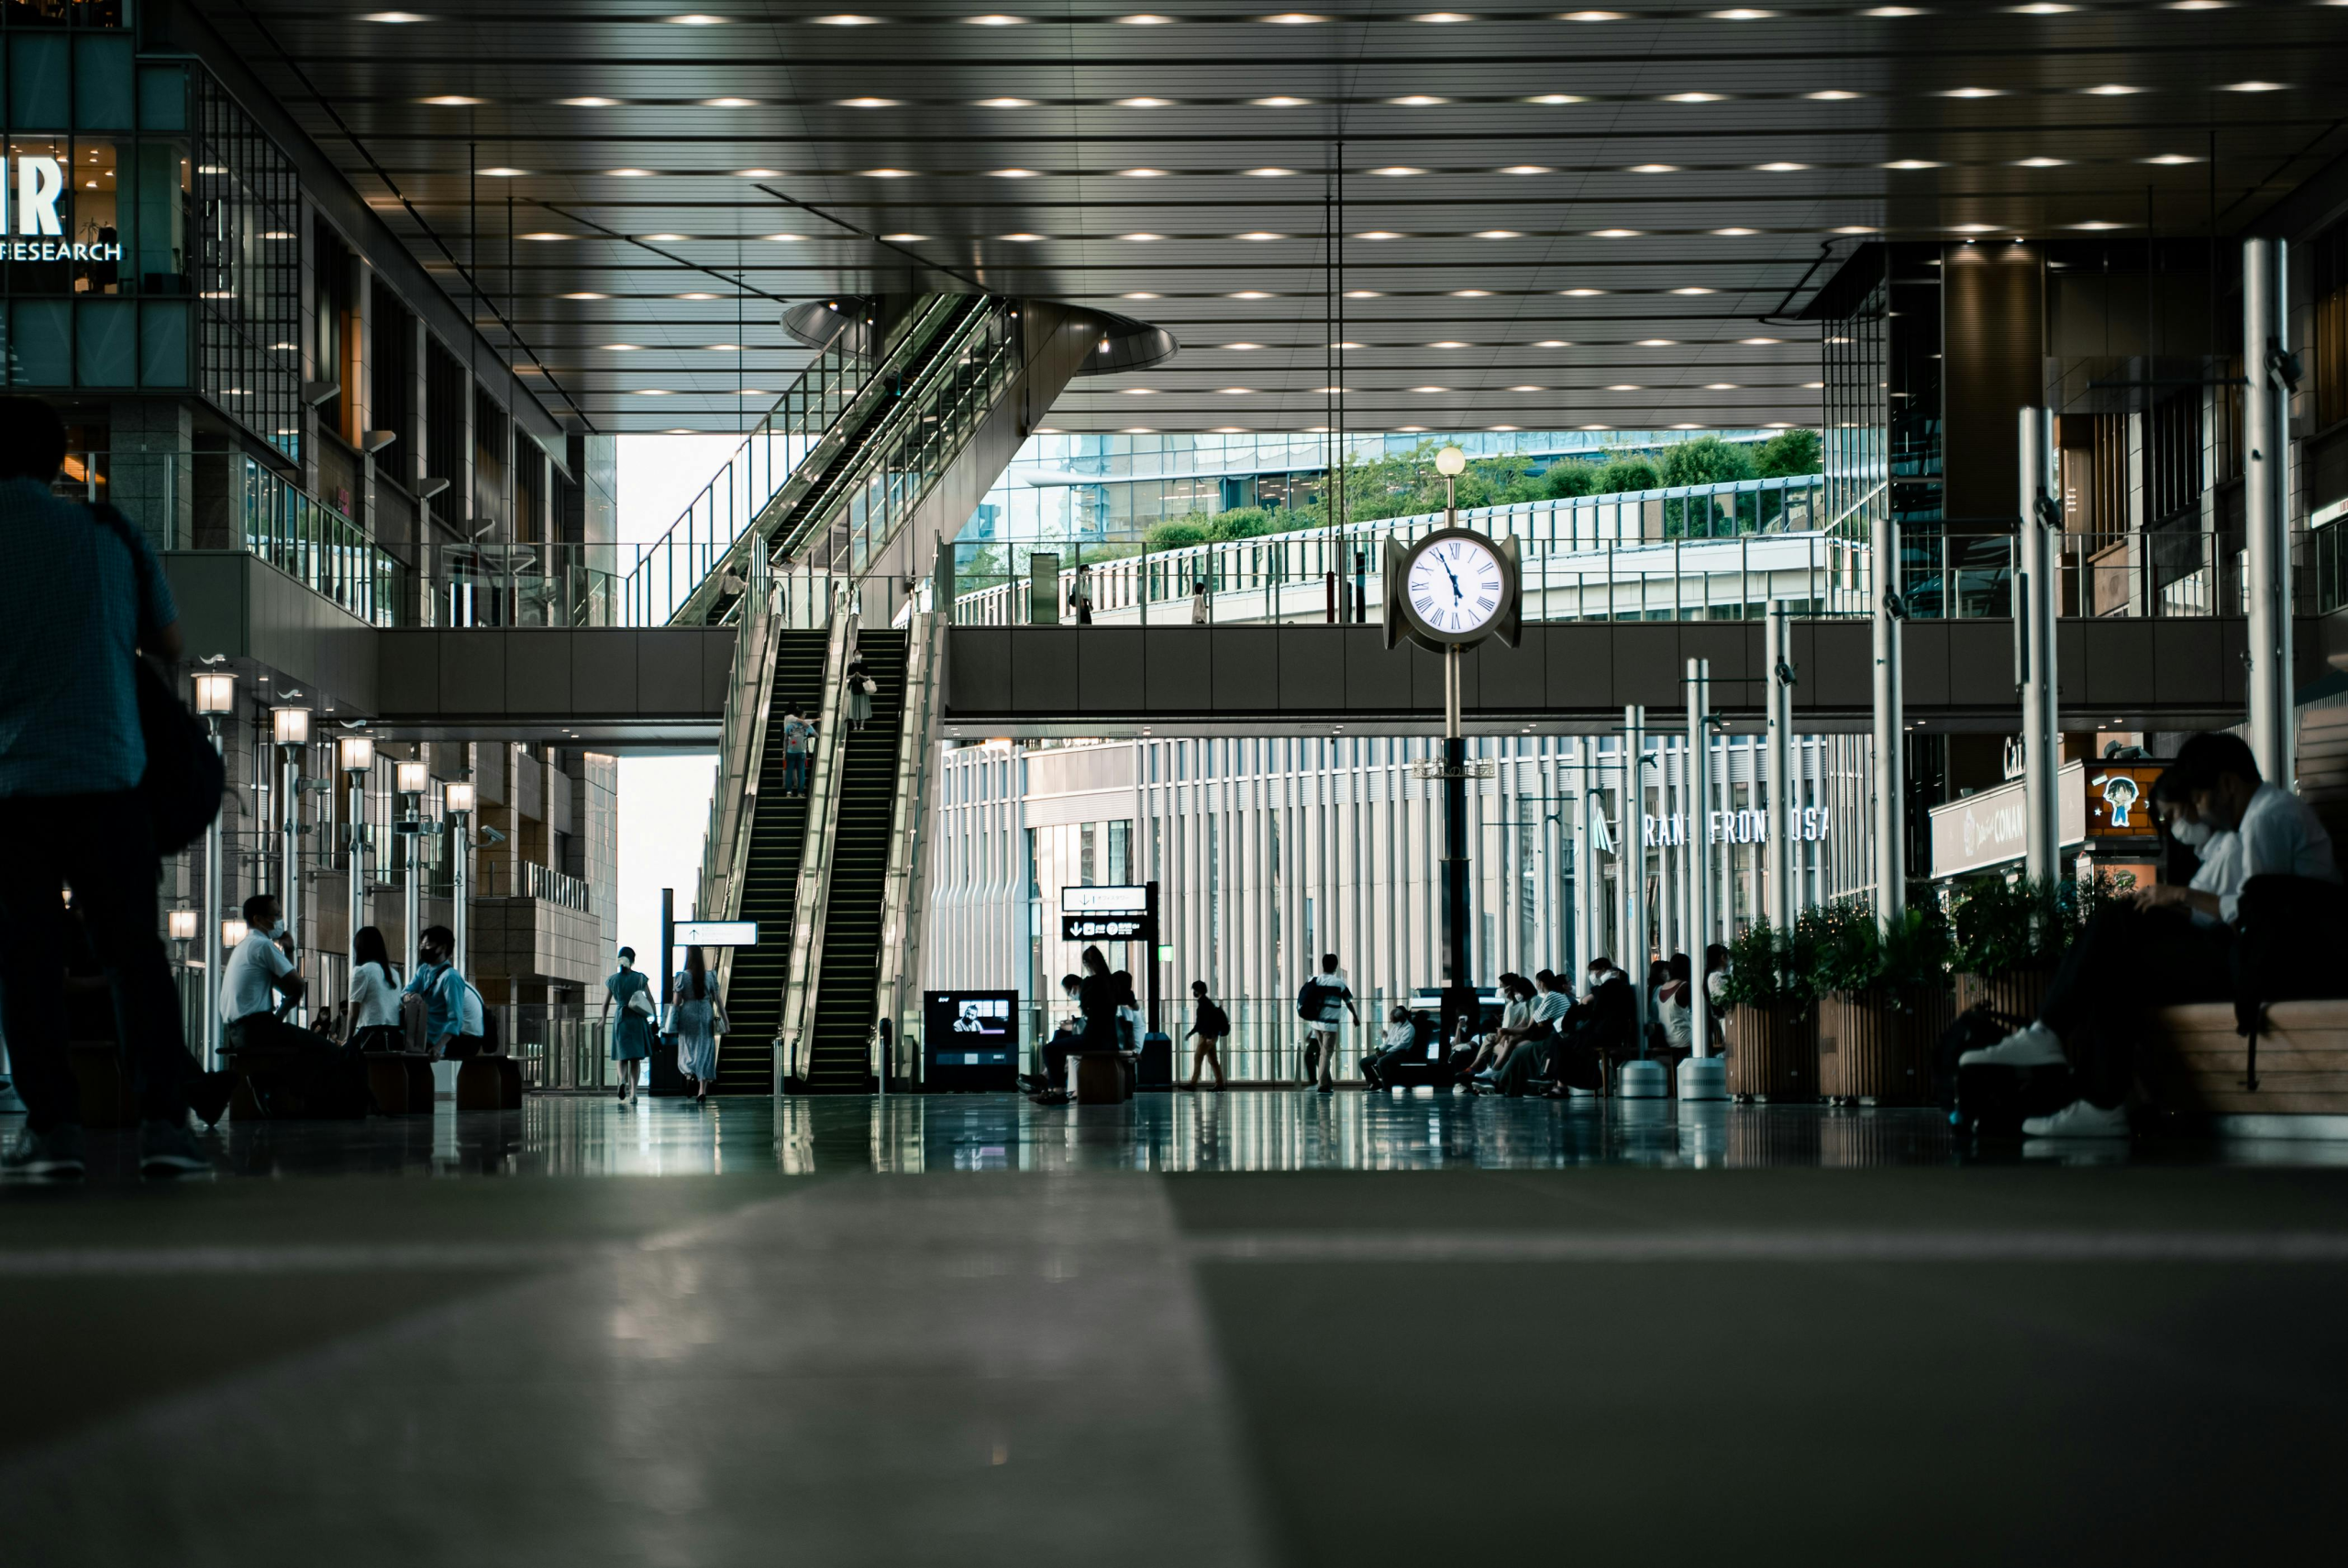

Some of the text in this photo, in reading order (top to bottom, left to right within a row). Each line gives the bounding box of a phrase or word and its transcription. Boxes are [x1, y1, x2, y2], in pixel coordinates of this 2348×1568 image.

[0, 156, 63, 236] R
[1448, 542, 1461, 560] XII
[1415, 561, 1434, 577] X
[1481, 580, 1499, 591] III
[1468, 608, 1481, 626] V
[1644, 806, 1829, 847] RAN FRON OSA
[1994, 803, 2023, 844] CONAN
